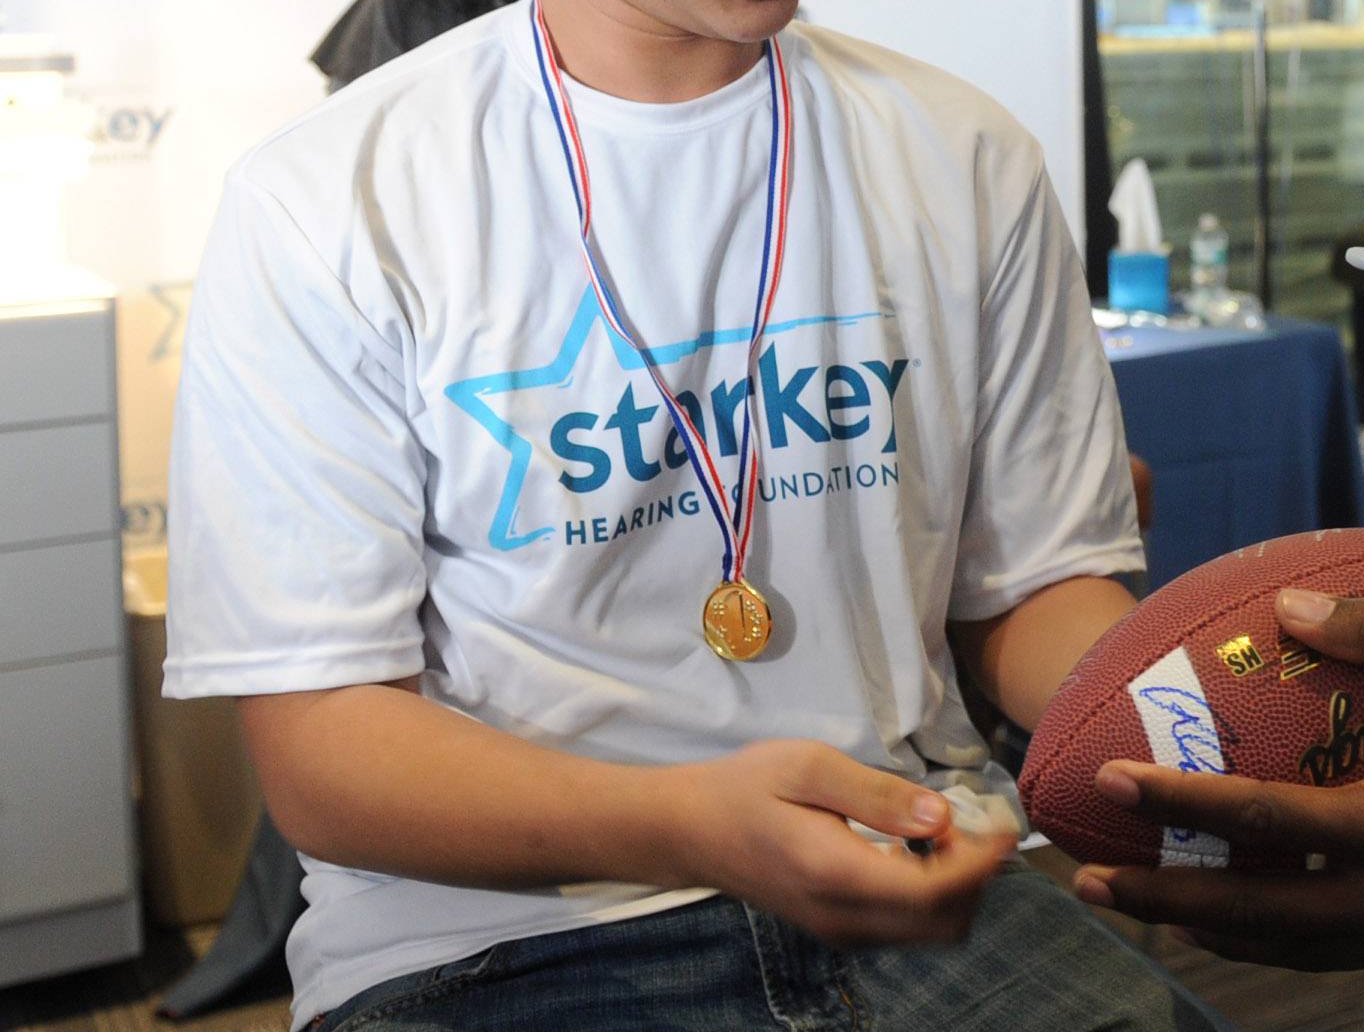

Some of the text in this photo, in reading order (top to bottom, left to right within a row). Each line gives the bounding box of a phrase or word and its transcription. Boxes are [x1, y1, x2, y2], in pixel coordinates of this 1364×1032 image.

[550, 342, 908, 494] starkey
[565, 462, 899, 546] HEARING UNDATION
